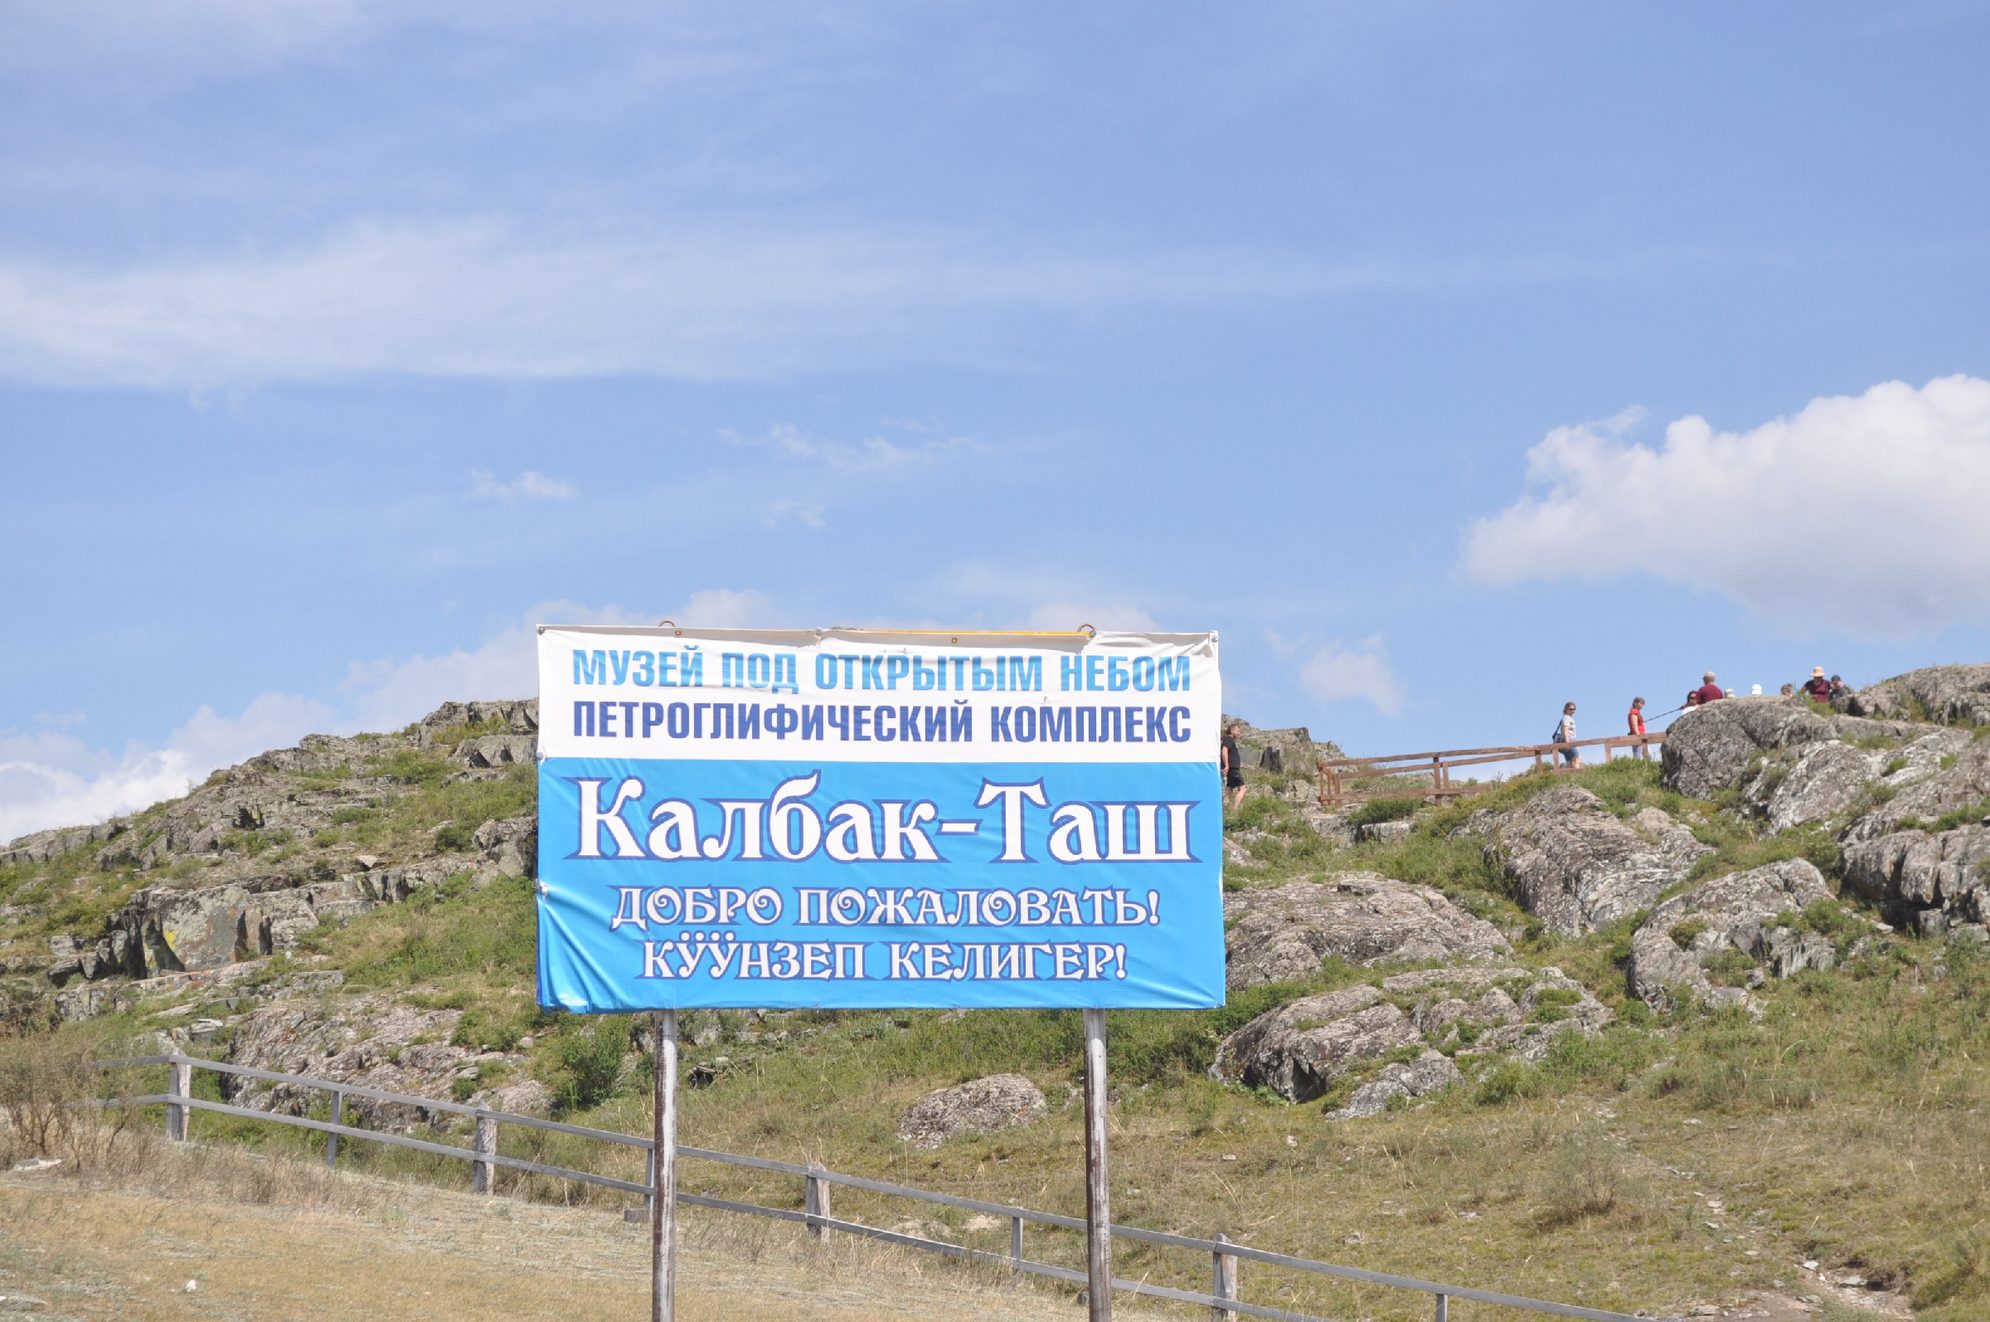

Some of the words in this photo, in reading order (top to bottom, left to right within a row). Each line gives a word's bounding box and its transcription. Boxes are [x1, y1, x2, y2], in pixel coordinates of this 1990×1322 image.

[572, 645, 703, 687] МУЗЕЙ
[722, 651, 799, 694] ПОД
[815, 654, 1043, 693] ОТКРЫТЫМ
[1060, 655, 1191, 692] НЕБОМ
[573, 699, 972, 742] ПЕТРОГЛИФИЧЕСКИЙ
[990, 705, 1191, 744] КОМПЛЕКС
[563, 769, 1203, 865] Калбак-Таш
[609, 885, 783, 932] ДОБРО
[793, 886, 1161, 927] ПОЖАЛОВАТЬ!
[884, 941, 1129, 982] КЕЛИГЕР!
